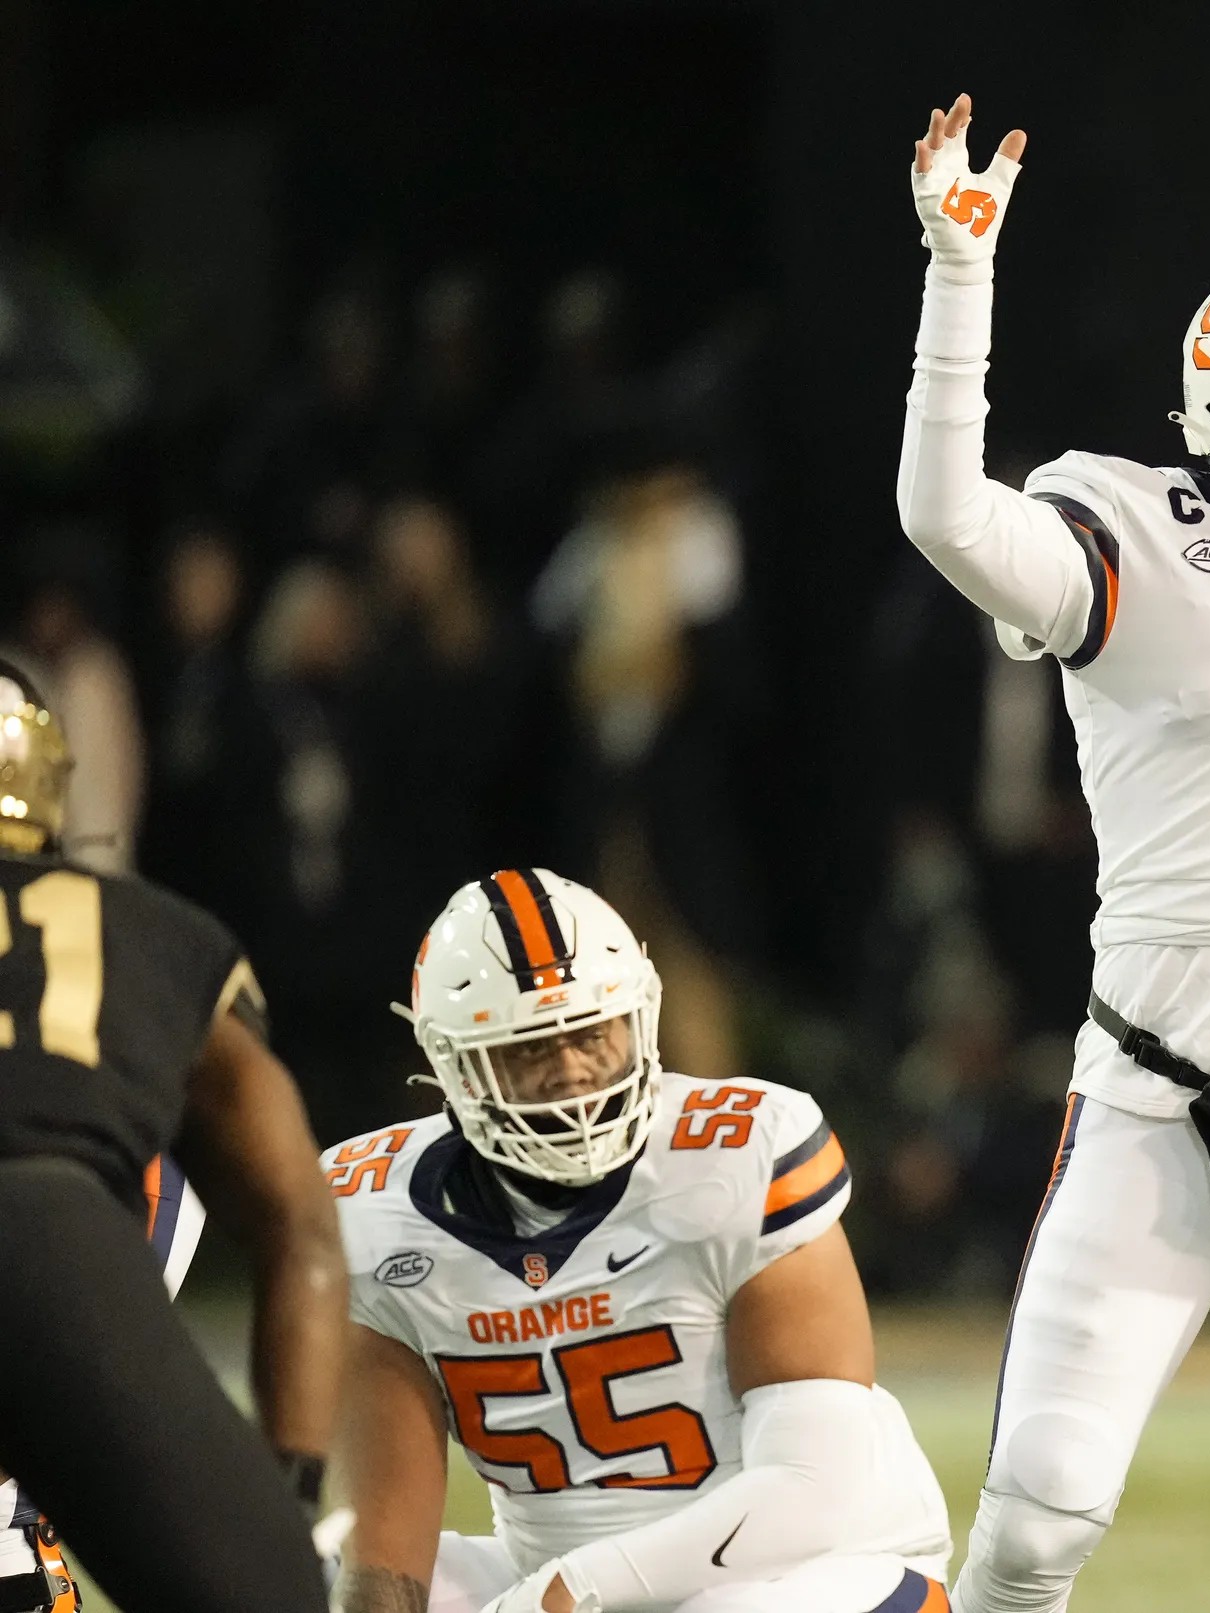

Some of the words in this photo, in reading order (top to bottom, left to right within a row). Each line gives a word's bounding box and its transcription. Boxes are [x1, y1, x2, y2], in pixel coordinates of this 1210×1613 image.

[1167, 486, 1205, 525] C
[0, 870, 105, 1071] 1
[669, 1086, 767, 1150] 55
[325, 1127, 416, 1198] 55
[384, 1256, 424, 1279] ACC
[523, 1253, 549, 1287] S
[466, 1293, 614, 1344] ORANGE
[432, 1323, 718, 1494] 55
